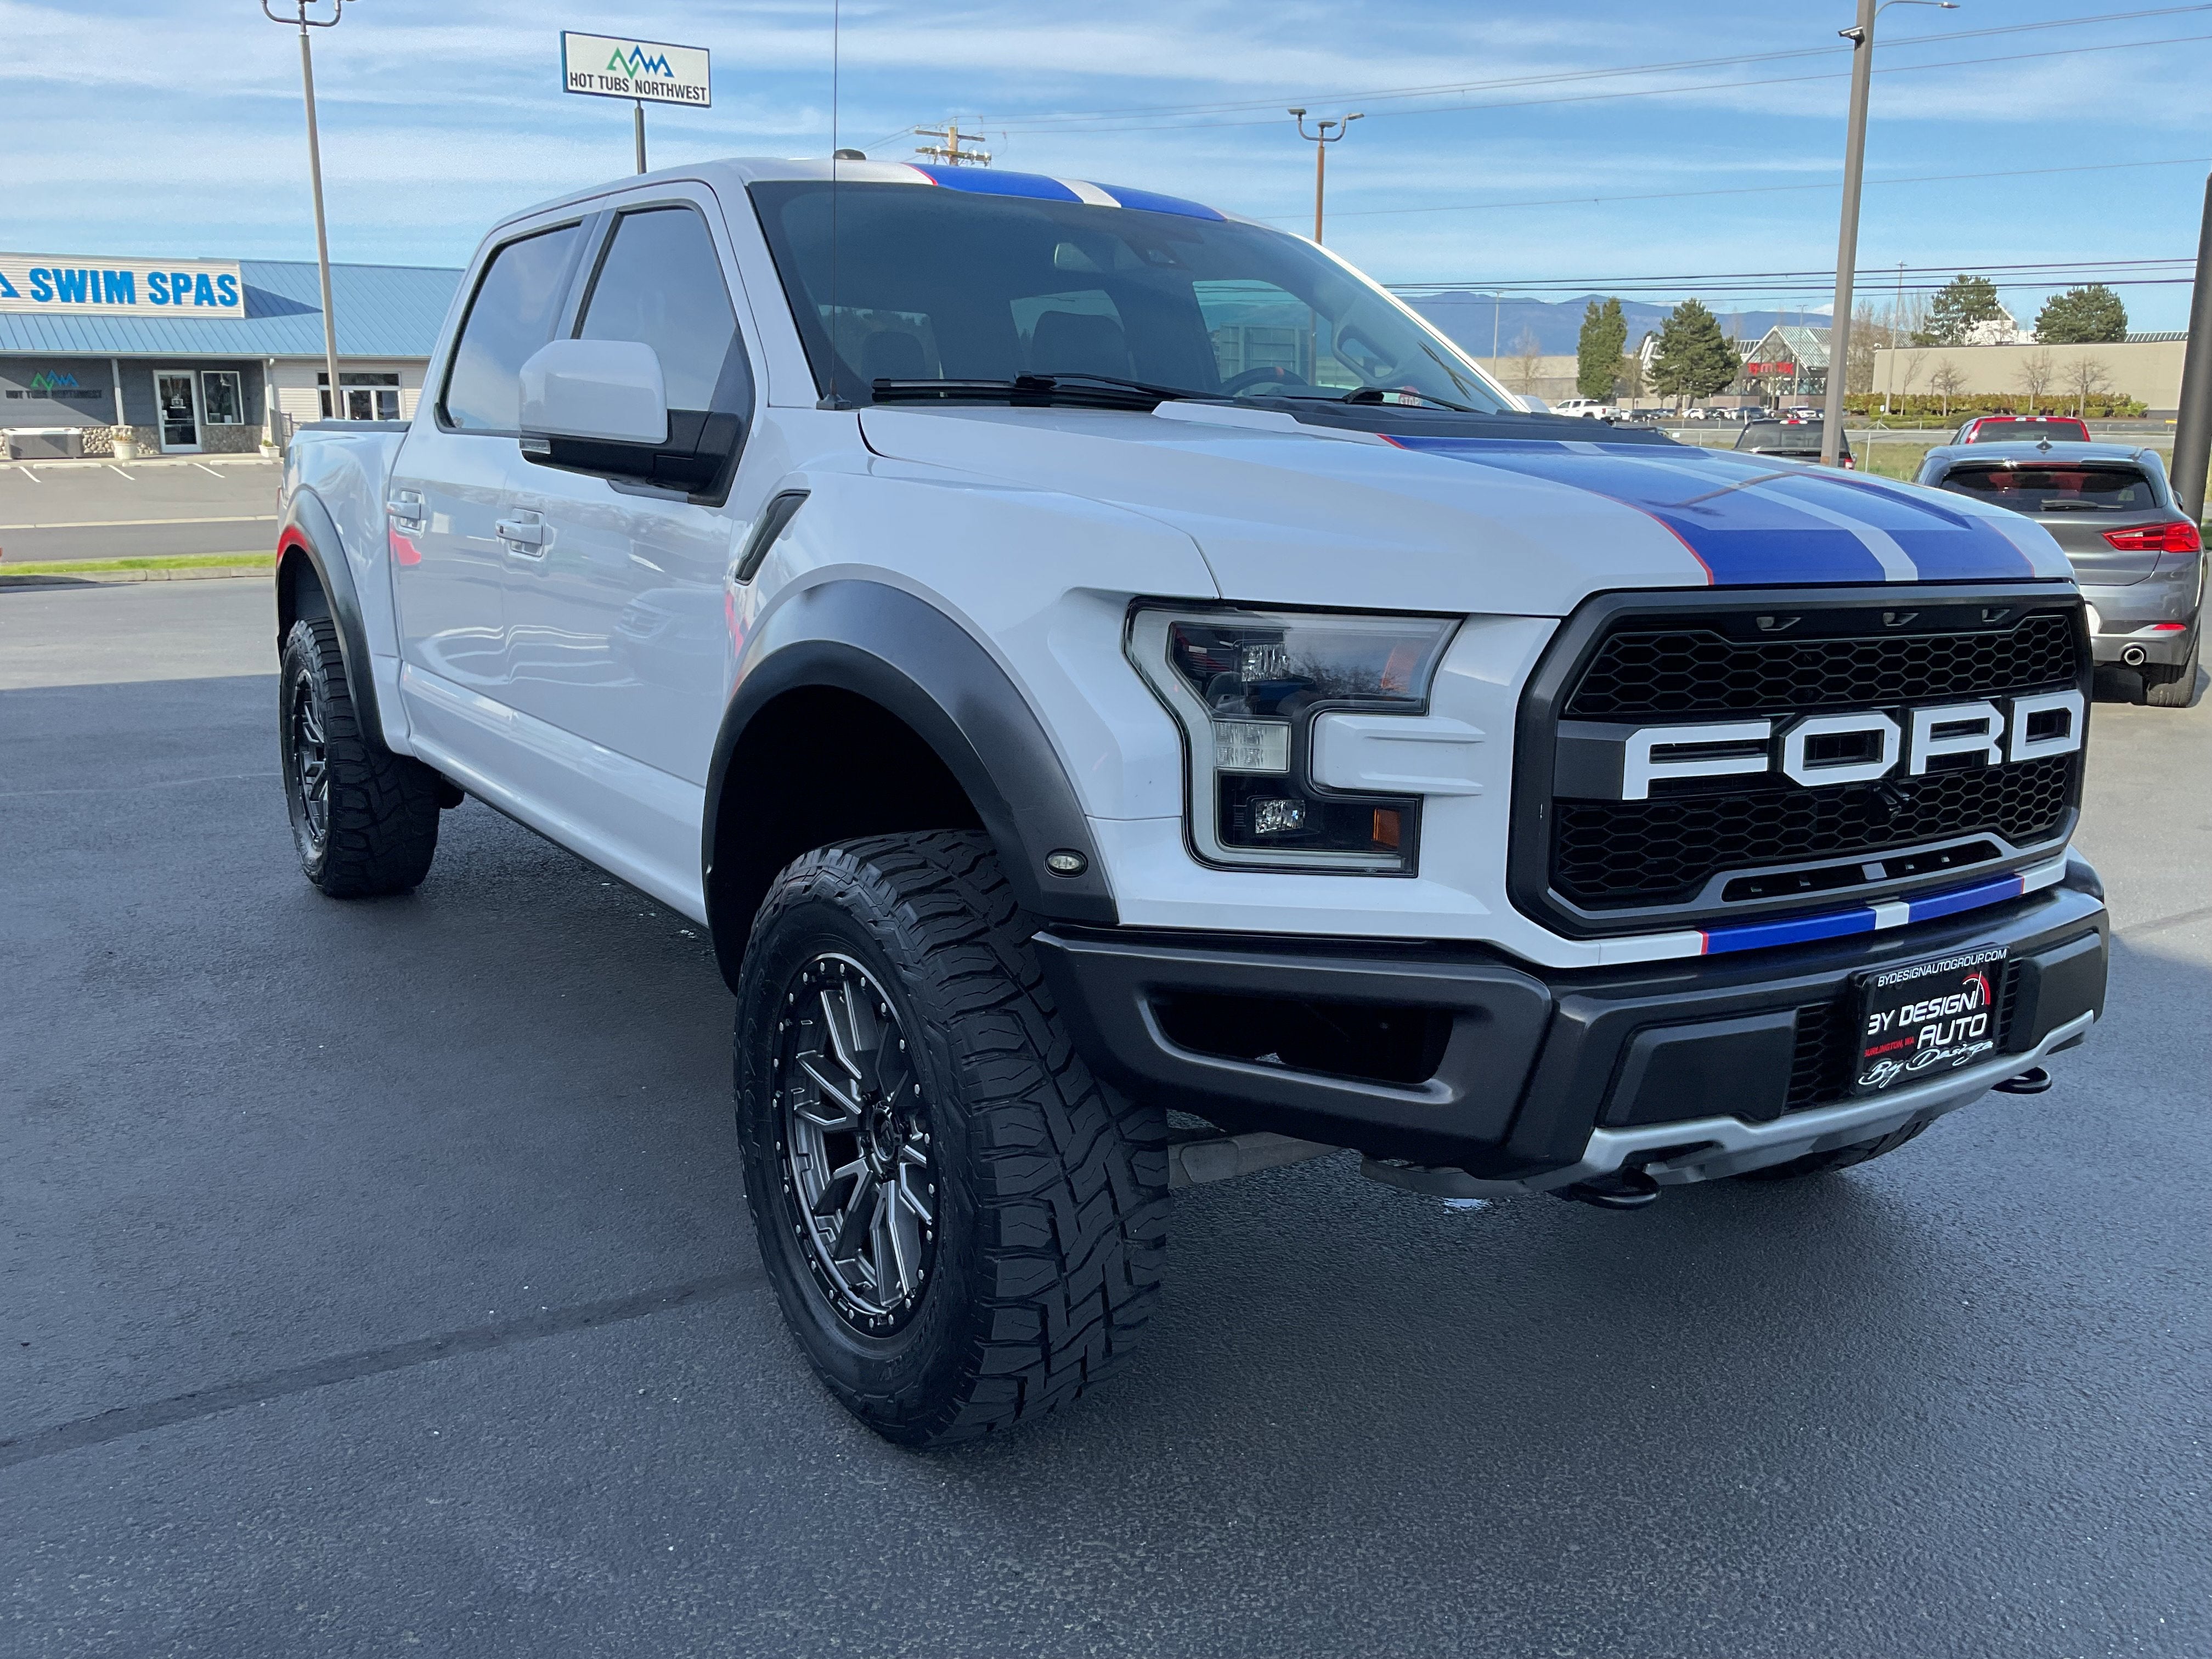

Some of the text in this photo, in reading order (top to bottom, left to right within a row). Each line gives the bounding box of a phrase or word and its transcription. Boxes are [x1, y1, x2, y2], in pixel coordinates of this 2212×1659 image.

[569, 72, 707, 101] HOT TUBS NORTHWEST
[29, 267, 239, 307] SWIM SPAS
[1622, 689, 2085, 800] FORD
[1877, 949, 2007, 988] BYDESIGNAUTOGROUP.COM
[1867, 990, 1977, 1035] BY DESIGN
[1917, 1013, 1987, 1049] AUTO
[1858, 1041, 1994, 1088] By Design
